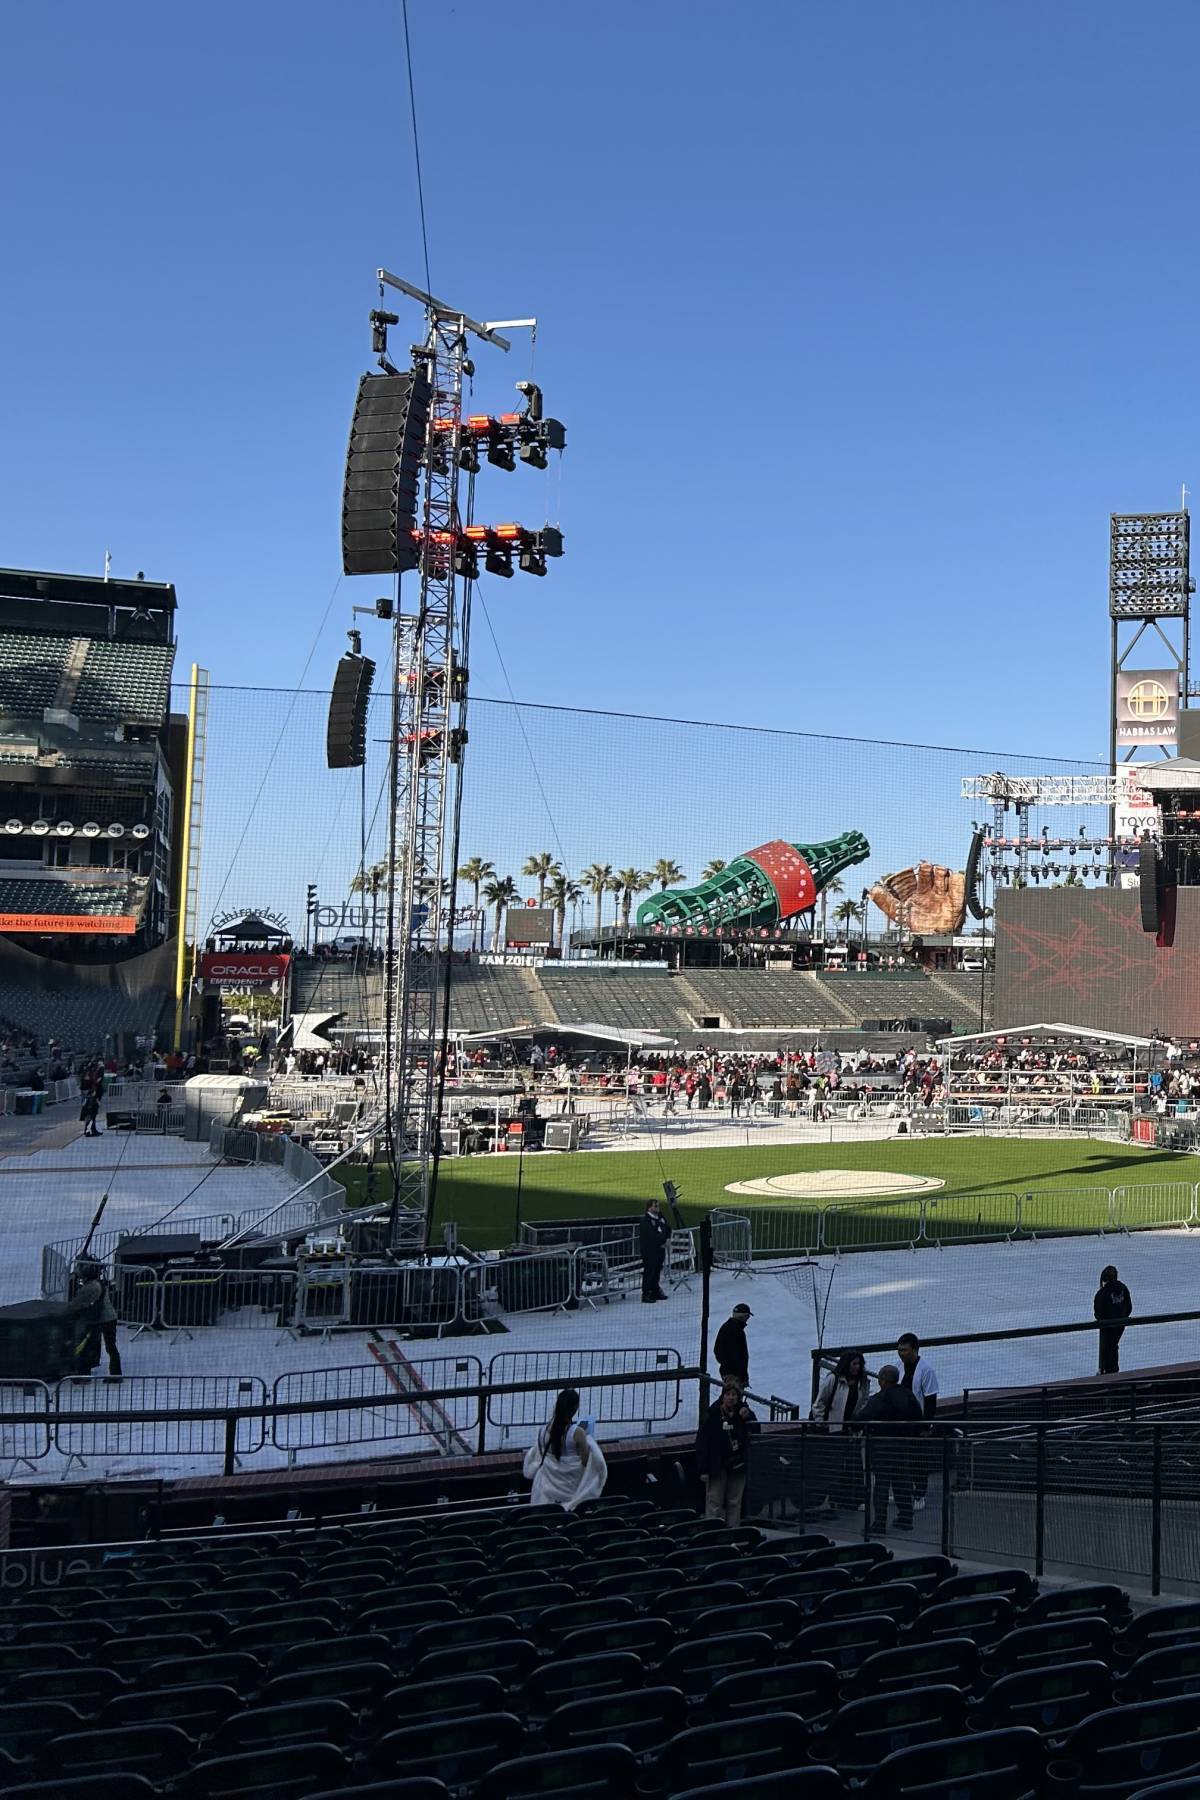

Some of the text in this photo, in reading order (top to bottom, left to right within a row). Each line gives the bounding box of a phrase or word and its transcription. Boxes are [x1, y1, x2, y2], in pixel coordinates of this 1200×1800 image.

[1119, 726, 1177, 737] HABBAS LAW
[1119, 816, 1157, 827] TOYO
[15, 916, 32, 927] the
[34, 916, 65, 928] future
[66, 917, 75, 928] is
[210, 906, 291, 929] Ghirardelli
[479, 955, 505, 966] FAN
[210, 965, 280, 975] ORACLE
[219, 985, 253, 996] EXIT
